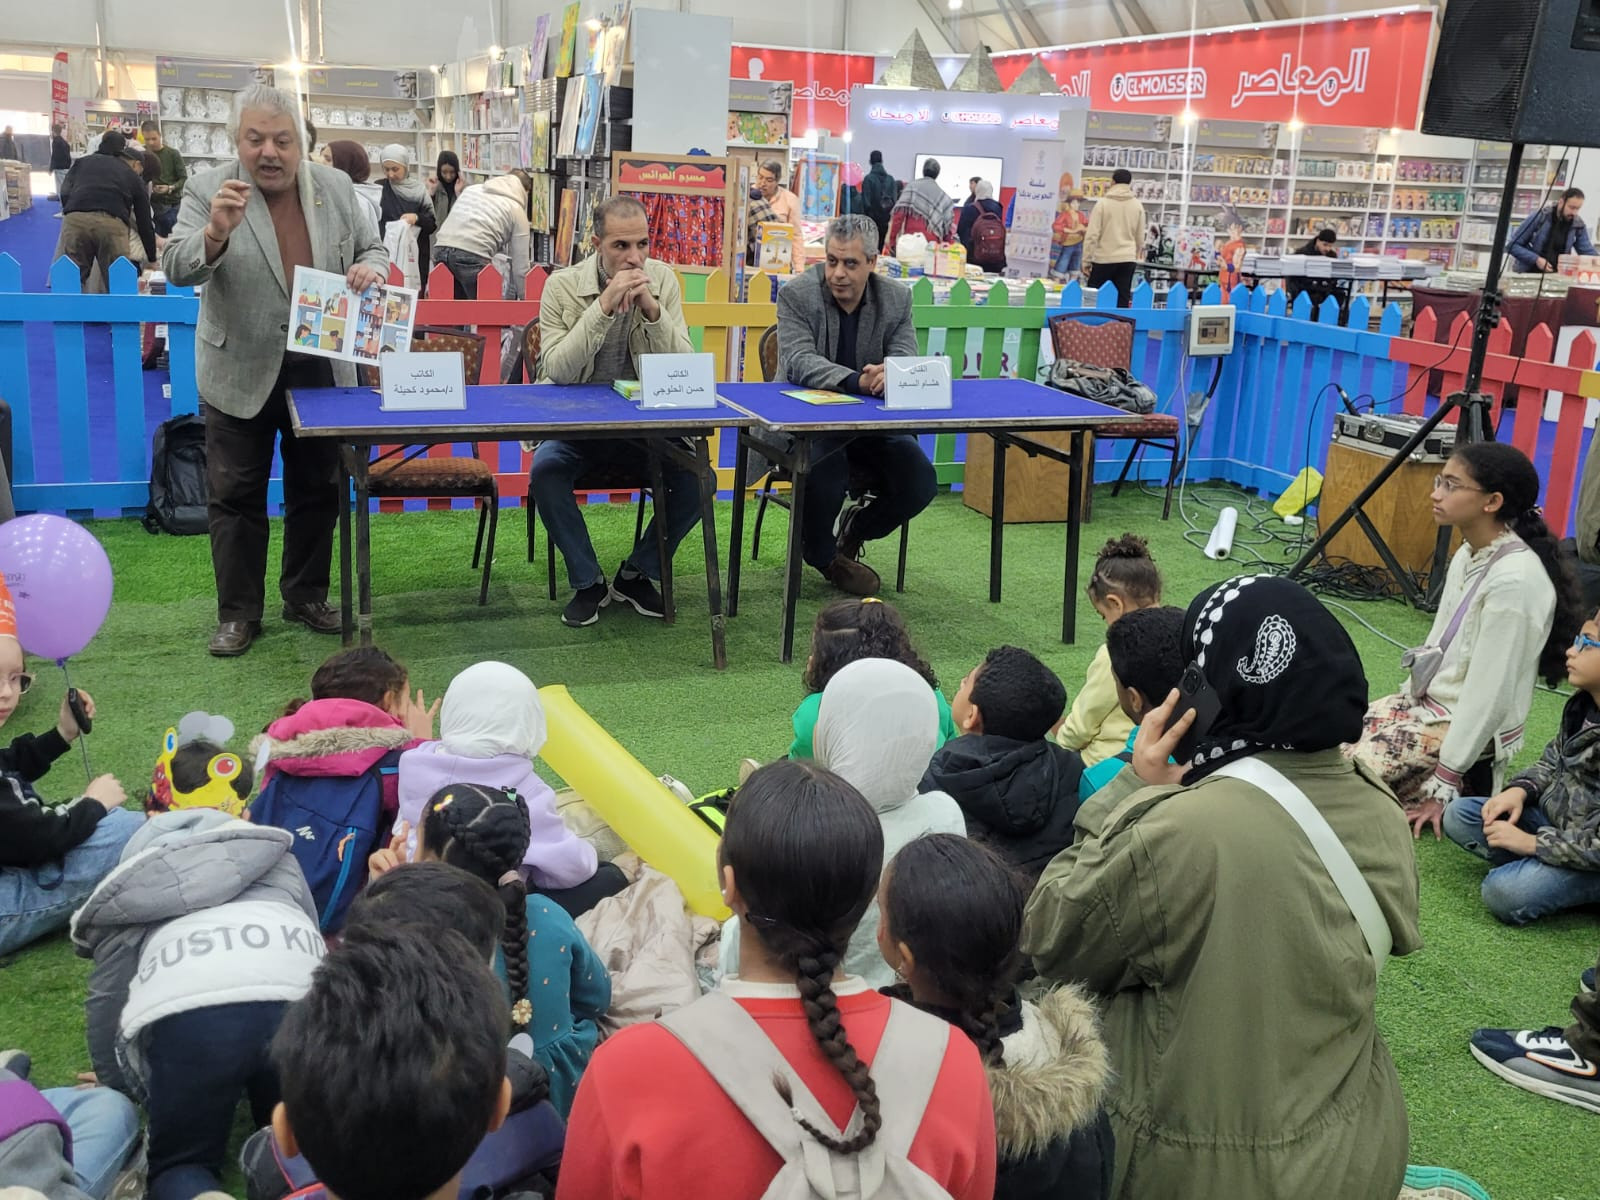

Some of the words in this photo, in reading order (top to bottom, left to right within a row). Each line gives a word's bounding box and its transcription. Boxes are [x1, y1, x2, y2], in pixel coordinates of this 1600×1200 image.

[1231, 47, 1370, 109] المعاصر
[638, 170, 676, 182] العرائس
[679, 173, 706, 183] مسرح
[410, 368, 435, 380] الكاتب
[666, 368, 689, 380] الكاتب
[419, 384, 453, 396] د/محمود
[686, 385, 705, 396] حسن
[138, 924, 270, 985] GUSTO
